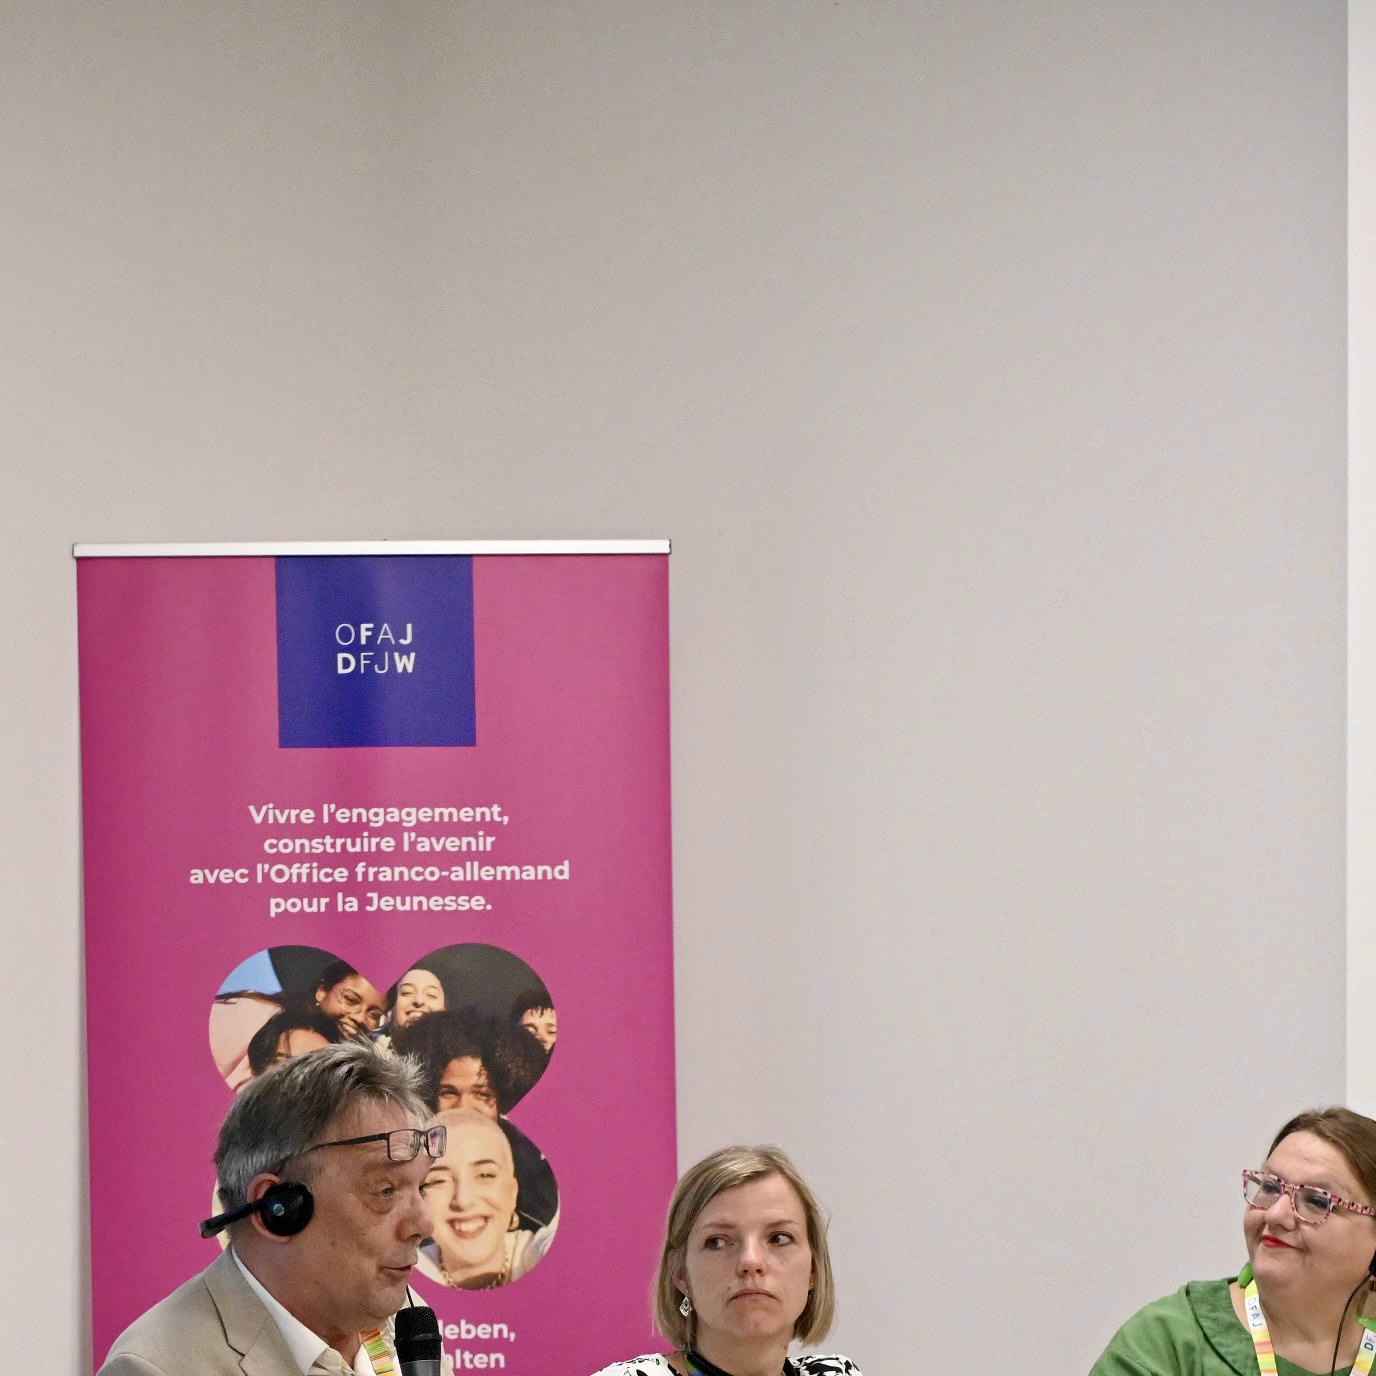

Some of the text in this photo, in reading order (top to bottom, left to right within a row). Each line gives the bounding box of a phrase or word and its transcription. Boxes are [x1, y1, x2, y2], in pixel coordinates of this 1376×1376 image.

[335, 623, 413, 646] OFAJ
[336, 651, 416, 674] DFJW
[248, 803, 510, 827] Vivre l’engagement,
[263, 830, 495, 854] construire l’avenir
[189, 860, 570, 884] avec l’Office franco-allemand
[269, 891, 493, 917] pour la Jeunesse.
